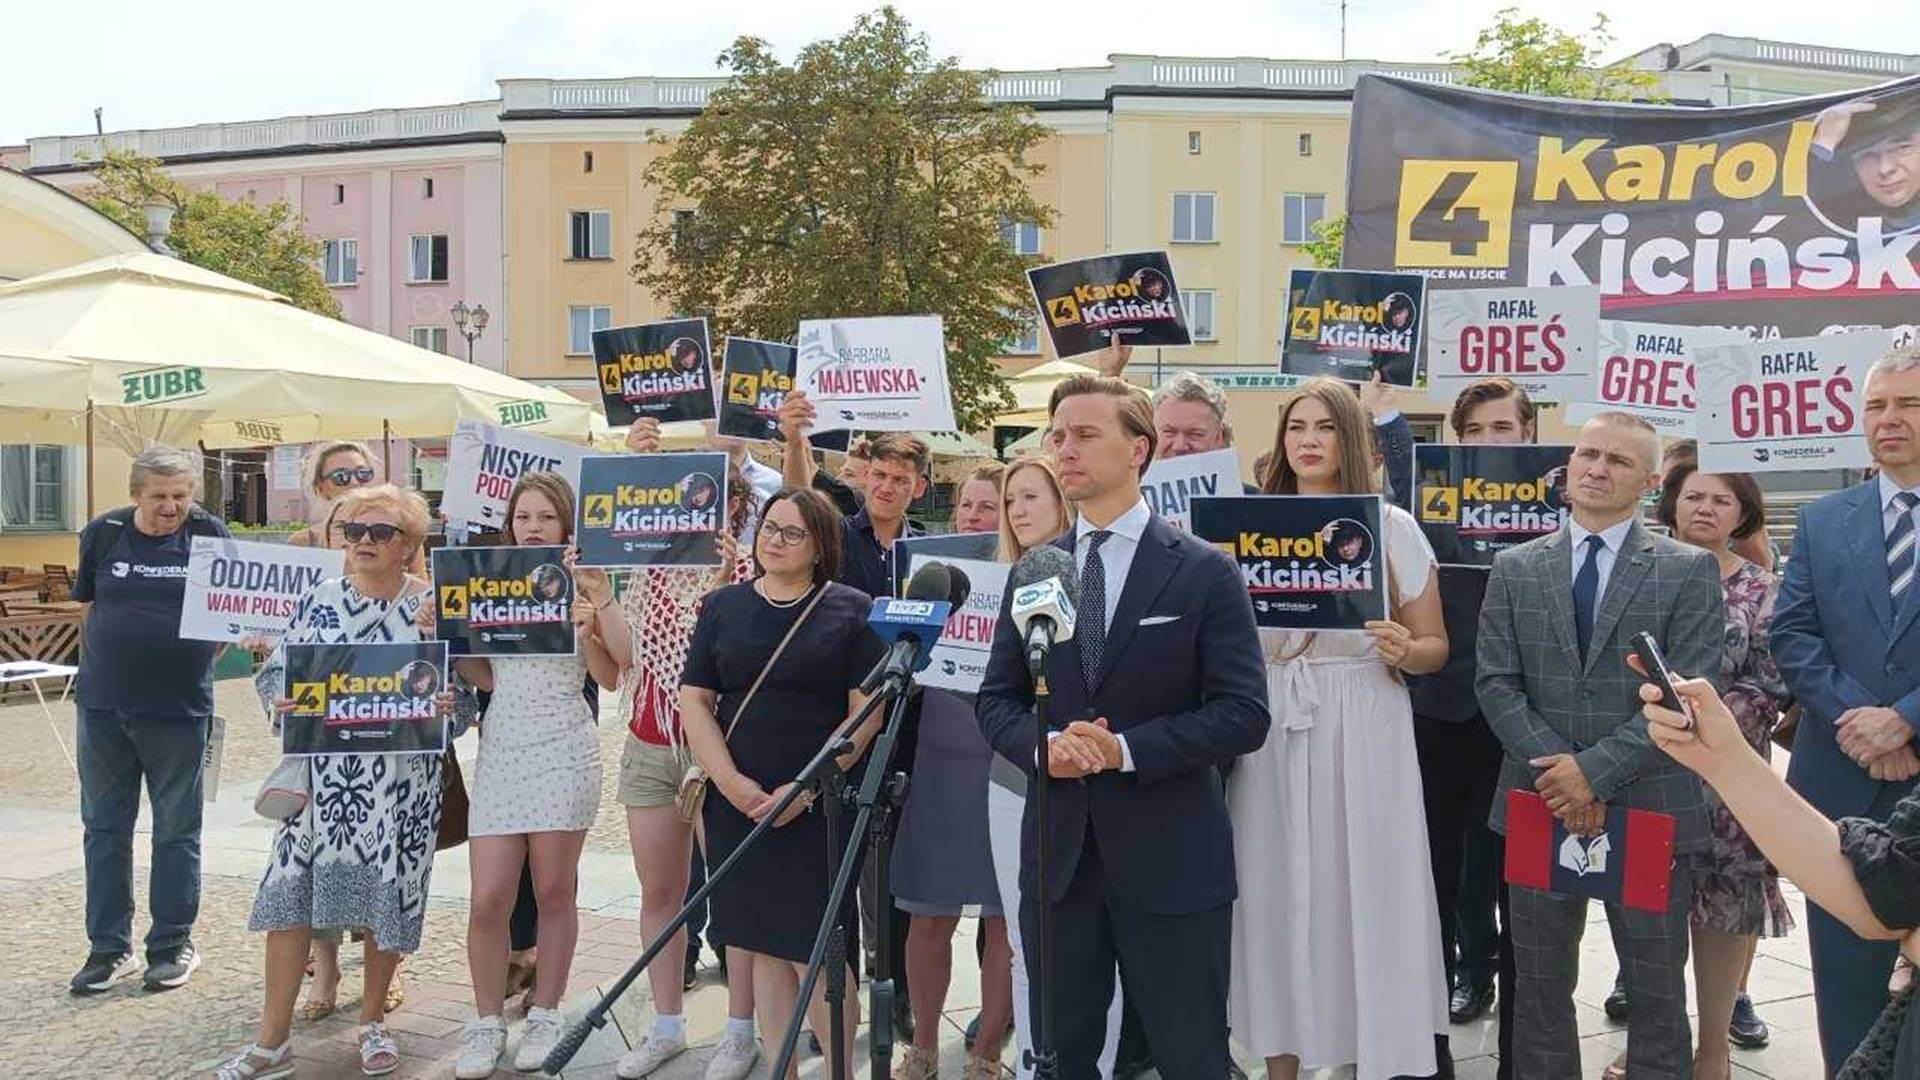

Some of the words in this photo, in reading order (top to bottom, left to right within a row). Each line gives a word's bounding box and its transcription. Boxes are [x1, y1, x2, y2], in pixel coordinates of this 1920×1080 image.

[1533, 121, 1819, 201] Karol
[1410, 171, 1489, 257] 4
[1527, 211, 1920, 297] Kicińsk
[1449, 269, 1467, 279] NA
[1075, 278, 1140, 302] Karol
[1081, 297, 1177, 324] Kiciński
[1323, 299, 1384, 324] Karol
[1487, 299, 1538, 320] RAFAŁ
[1320, 323, 1412, 353] Kiciński
[1459, 314, 1566, 374] GREŚ
[1636, 334, 1685, 356] RAFAŁ
[621, 349, 673, 373] Karol
[1761, 351, 1819, 376] RAFAŁ
[623, 367, 706, 396] Kiciński
[761, 368, 796, 391] Ka
[818, 367, 919, 394] MAJEWSKA
[1731, 365, 1855, 440] GREŚ
[617, 482, 682, 506] Karol
[1462, 477, 1546, 502] Karol
[615, 507, 717, 532] Kiciński
[1461, 503, 1568, 531] Kicińs
[1239, 532, 1325, 558] Karol
[210, 558, 322, 595] ODDAMY
[469, 575, 534, 598] Karol
[1240, 560, 1373, 590] Kiciński
[207, 592, 247, 615] WAM
[251, 596, 297, 618] POLS
[469, 598, 568, 622] Kiciński
[945, 613, 994, 644] AJEW
[329, 670, 404, 694] Karol
[328, 694, 437, 721] Kiciński
